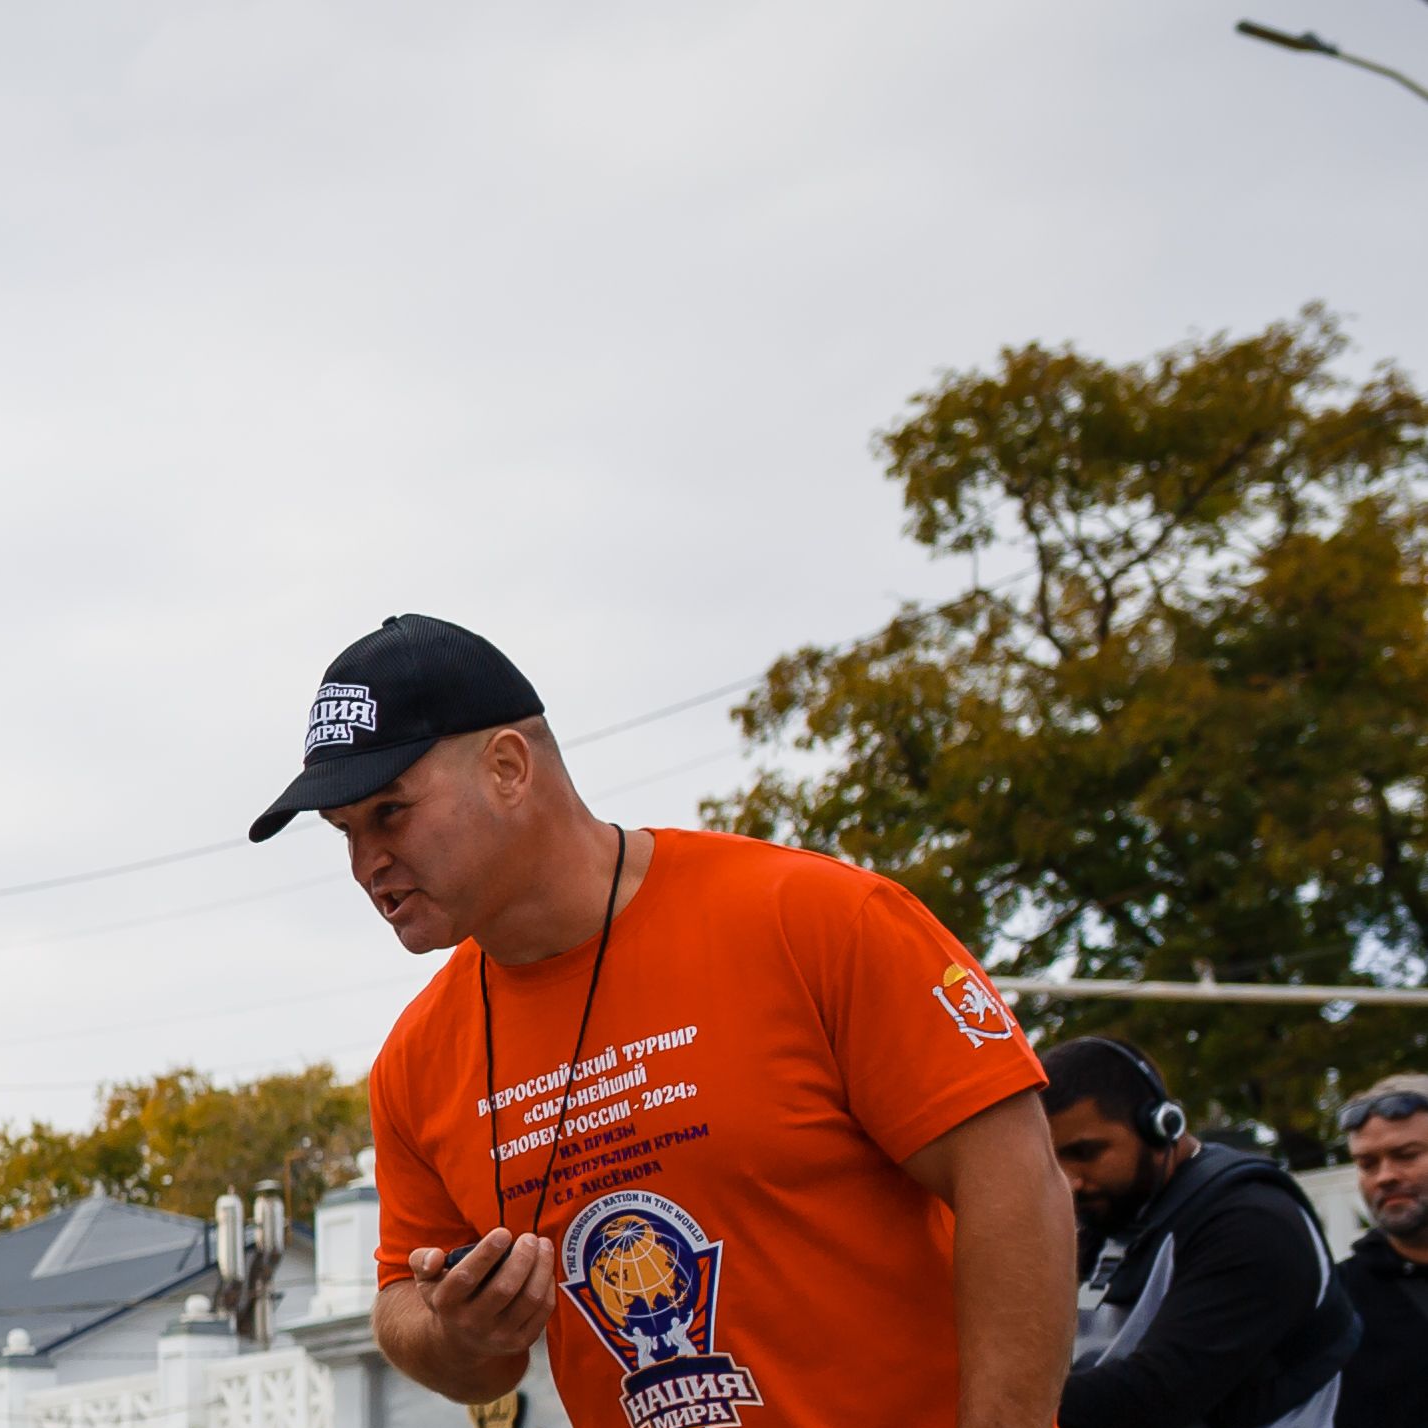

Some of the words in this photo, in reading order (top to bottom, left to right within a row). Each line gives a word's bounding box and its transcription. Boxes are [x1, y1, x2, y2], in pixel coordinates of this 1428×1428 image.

[309, 700, 371, 724] ЦИЯ
[621, 1026, 697, 1061] ТУРНИР
[564, 1100, 631, 1137] РОССИИ
[585, 1124, 635, 1152] ПРИЗЫ
[502, 1175, 547, 1200] ЛАВЫ
[553, 1140, 652, 1184] РЕСПУБЛИКИ
[654, 1123, 709, 1150] КРЫМ
[603, 1193, 639, 1208] NATION
[642, 1194, 651, 1203] IN
[654, 1198, 673, 1214] THE
[567, 1205, 602, 1252] STRONGEST
[674, 1209, 705, 1243] WORLD
[567, 1254, 577, 1275] THE
[627, 1374, 751, 1424] НАЦИЯ
